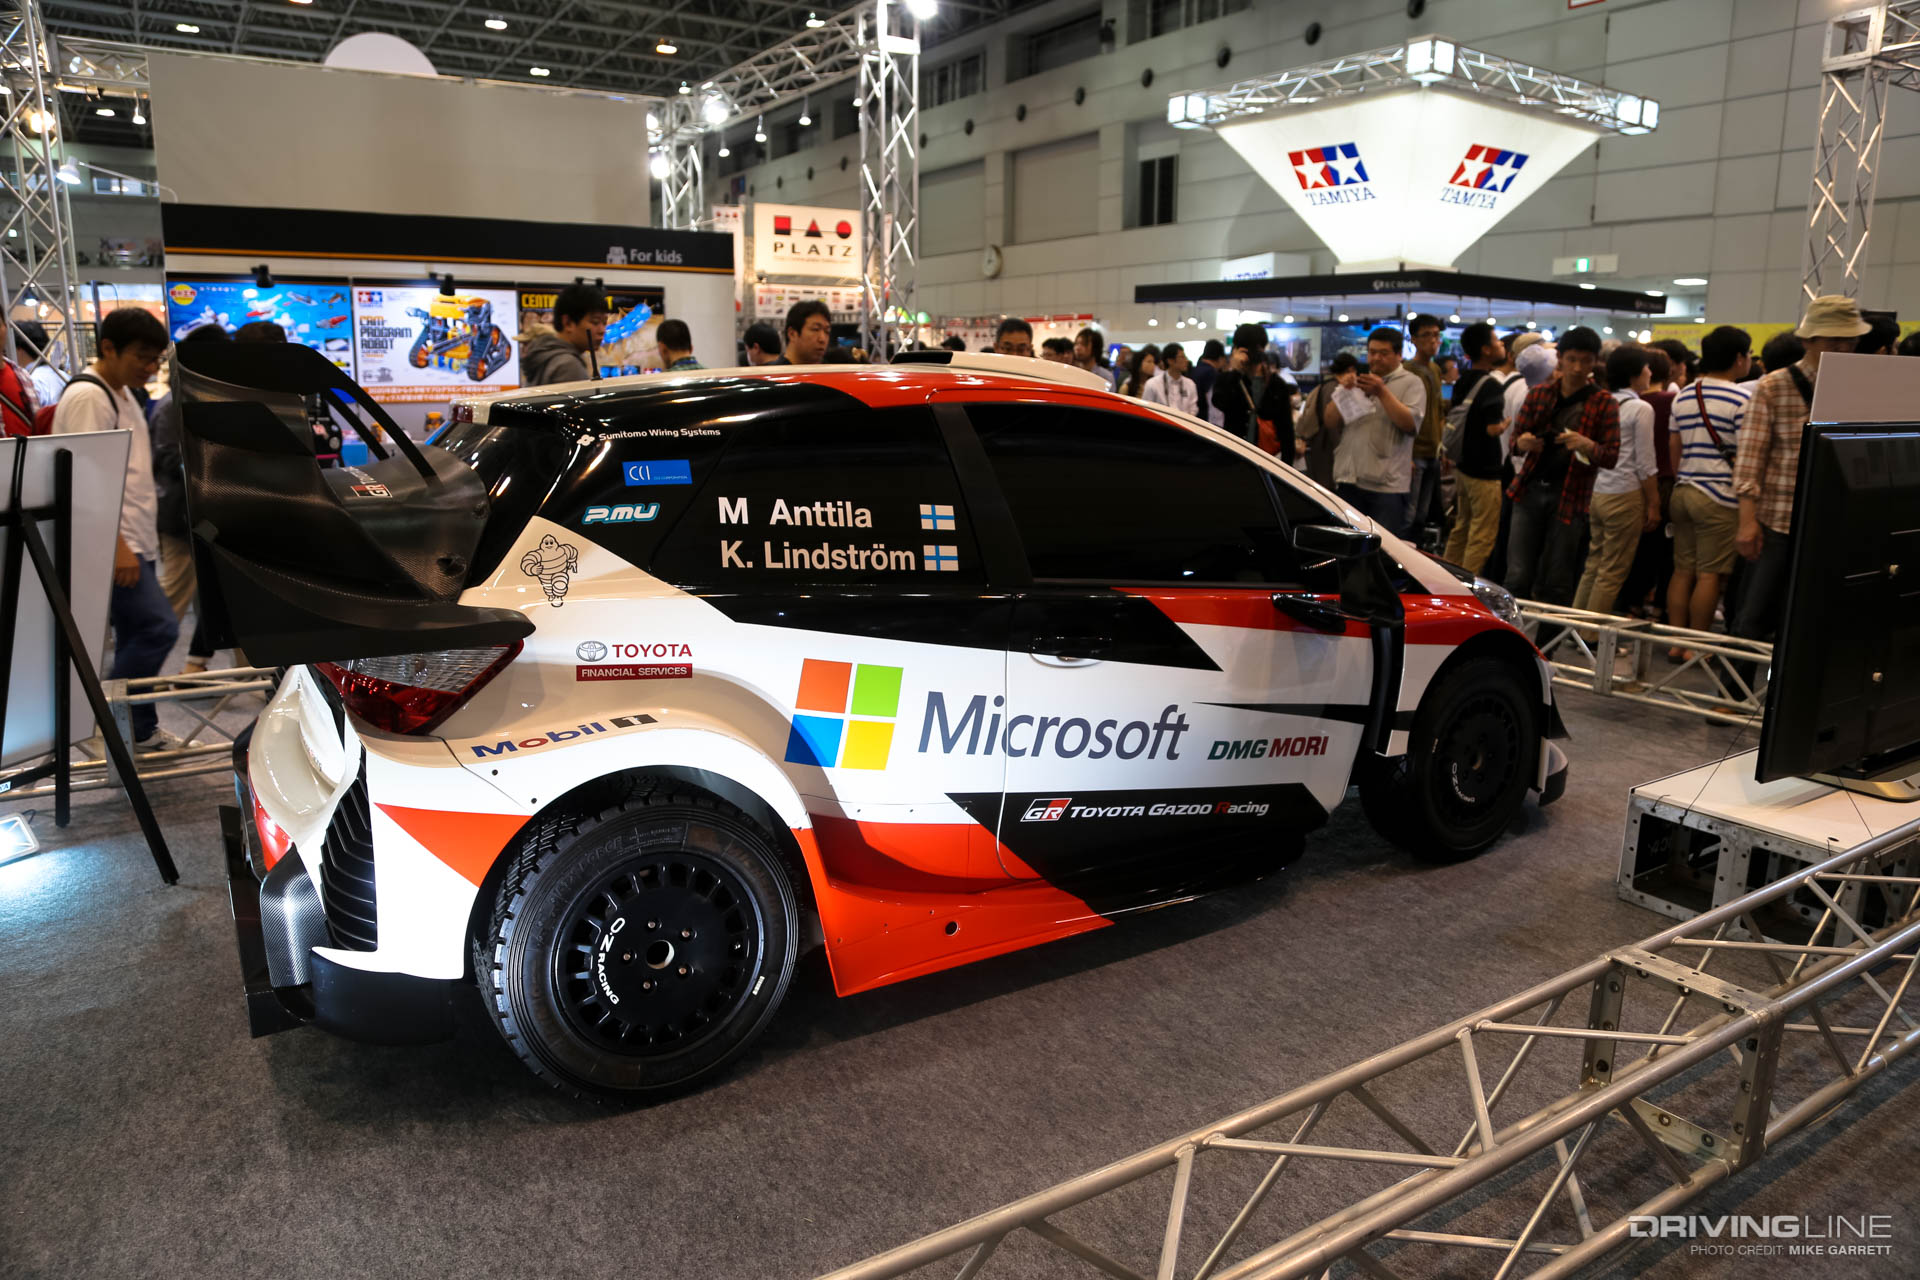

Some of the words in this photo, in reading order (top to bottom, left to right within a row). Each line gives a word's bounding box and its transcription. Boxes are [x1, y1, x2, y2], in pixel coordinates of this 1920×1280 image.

[1305, 186, 1377, 206] TAMIYA
[1440, 186, 1498, 210] TAMIYA
[629, 249, 651, 263] For
[655, 249, 683, 265] kids
[773, 241, 855, 257] PLATZ
[360, 328, 412, 338] PROGRAM
[361, 339, 394, 350] ROBOT
[598, 430, 647, 441] Sumitomo
[649, 429, 679, 437] Wiring
[681, 428, 721, 436] Systems
[718, 497, 749, 525] M
[769, 498, 872, 528] Anttila
[721, 540, 753, 568] K.
[764, 541, 916, 570] Lindström
[612, 643, 692, 658] TOYOTA
[582, 668, 636, 677] FINANCIAL
[638, 667, 687, 676] SERVICES
[918, 691, 1190, 761] Microsoft
[471, 722, 607, 758] Mobil
[1207, 739, 1268, 760] DMG
[1268, 736, 1329, 758] MORI
[1025, 807, 1062, 820] GR
[1070, 806, 1145, 818] TOYOTA
[1149, 803, 1212, 816] GAZOO
[1214, 801, 1270, 816] Racing
[597, 952, 620, 1005] RACING
